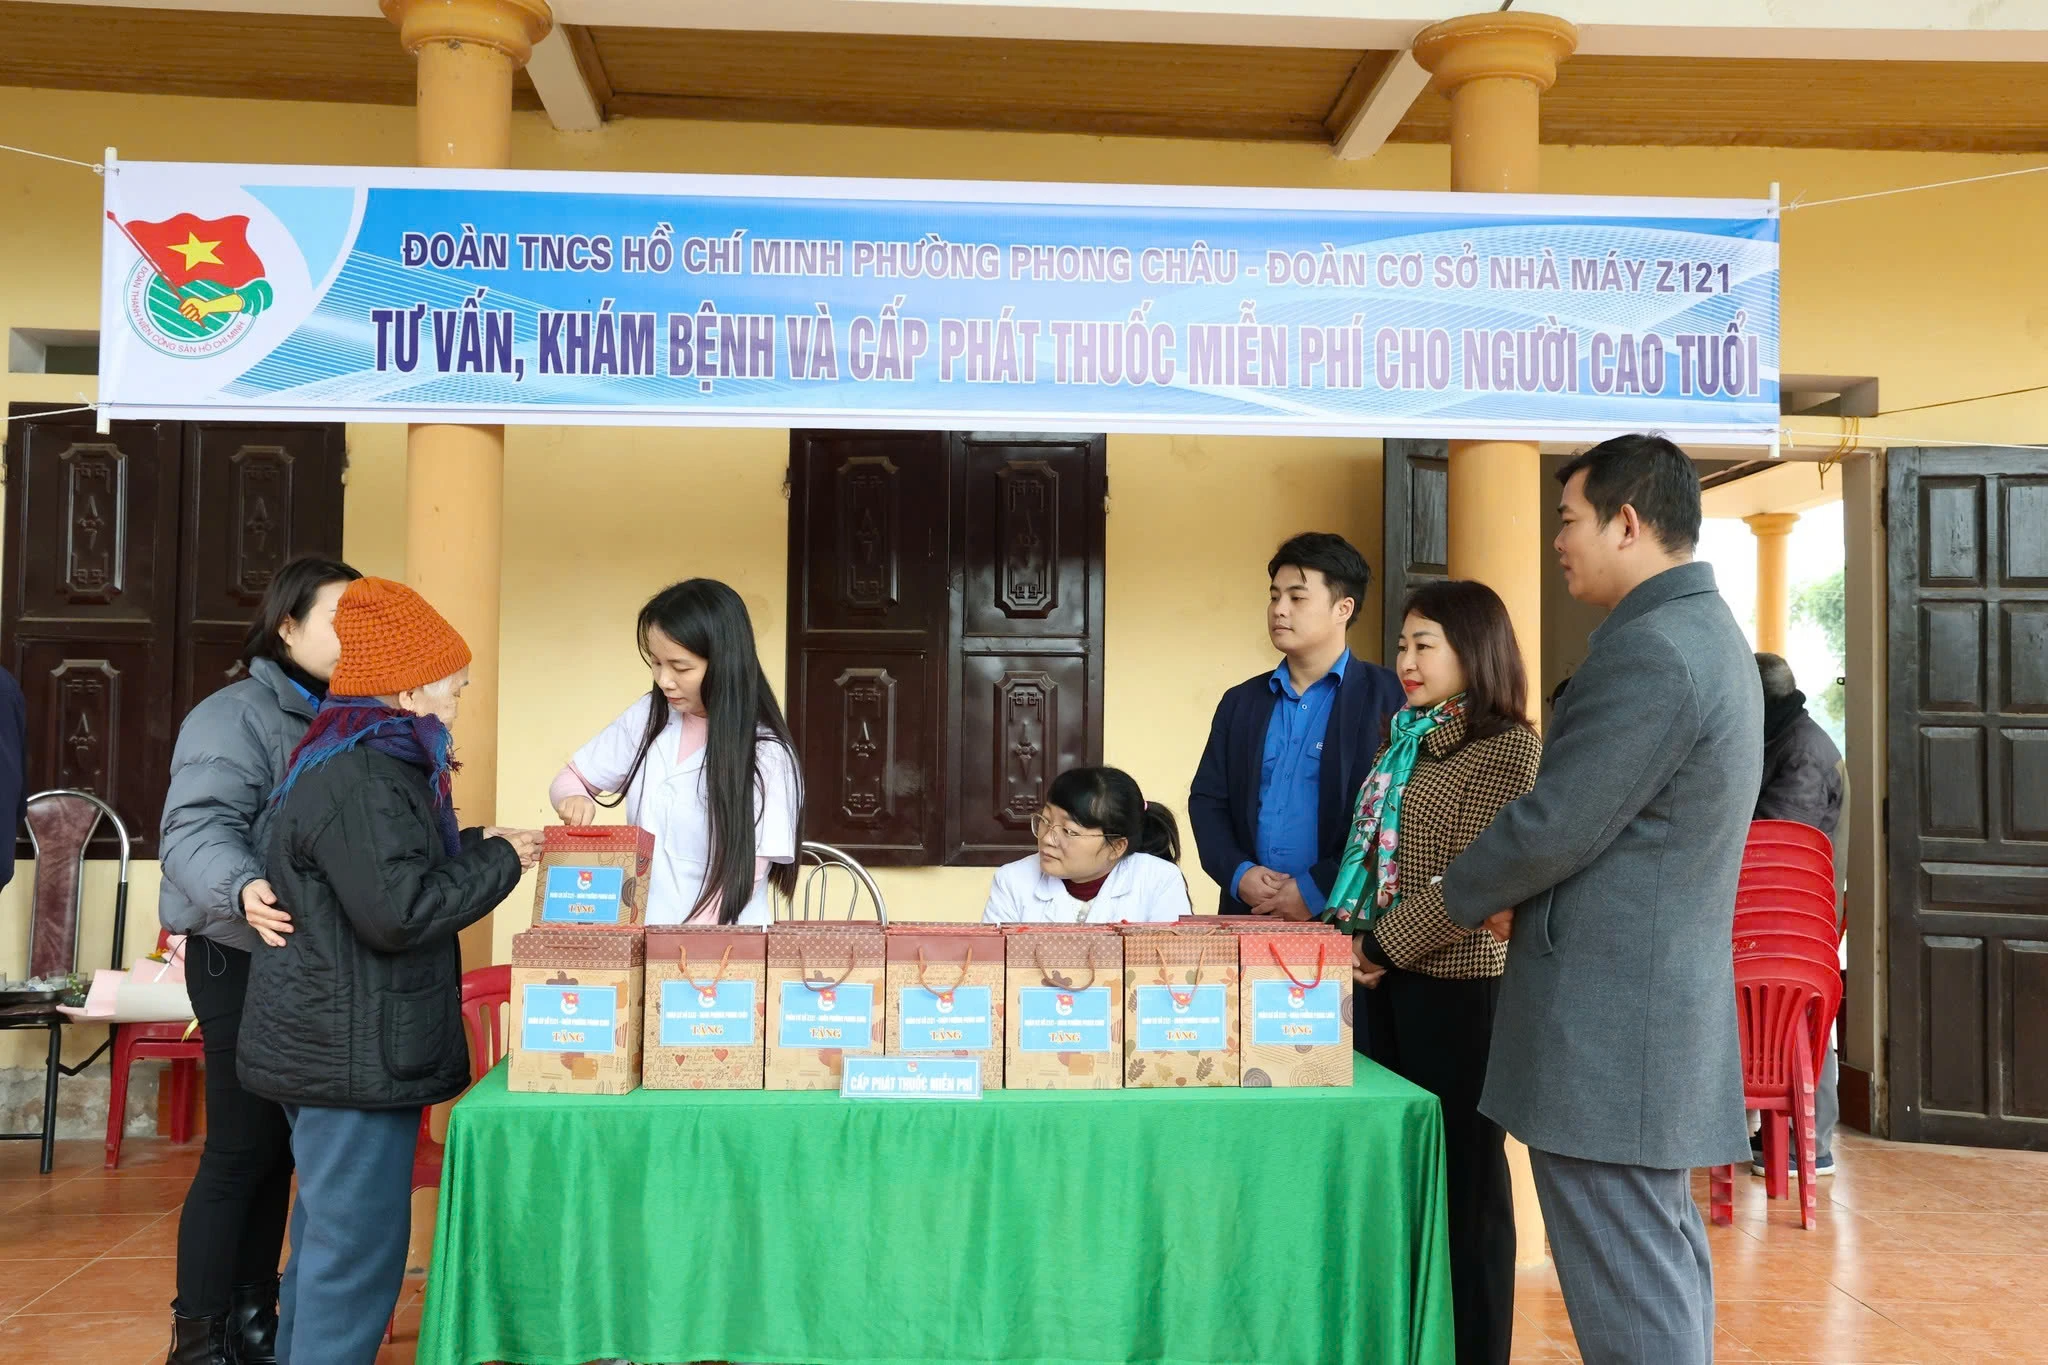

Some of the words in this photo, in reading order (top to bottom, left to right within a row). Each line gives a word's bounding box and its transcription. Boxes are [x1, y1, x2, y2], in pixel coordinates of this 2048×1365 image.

[402, 223, 507, 269] ĐOÀN
[518, 233, 612, 272] TNCS
[622, 222, 674, 273] HỒ
[682, 229, 747, 274] CHÍ
[751, 239, 843, 276] MINH
[853, 232, 1000, 280] PHƯỜNG
[1010, 245, 1131, 283] PHONG
[1140, 240, 1238, 284] CHÂU
[1266, 243, 1366, 287] ĐOÀN
[1376, 252, 1423, 288] CƠ
[1434, 242, 1479, 290] SỞ
[1490, 247, 1560, 292] NHÀ
[1571, 250, 1645, 293] MÁY
[1656, 262, 1731, 294] Z121
[131, 291, 142, 318] THANH
[227, 321, 246, 341] MINH
[371, 303, 426, 373] TƯ
[432, 286, 526, 383] VẤN,
[538, 298, 655, 376] KHÁM
[668, 299, 774, 392] BỆNH
[786, 302, 838, 381] VÀ
[849, 294, 929, 382] CẤP
[939, 306, 1040, 383] PHÁT
[1051, 300, 1177, 386] THUỐC
[1187, 299, 1288, 388] MIỄN
[1300, 313, 1364, 390] PHÍ
[1375, 327, 1450, 391] CHO
[1463, 316, 1577, 393] NGƯỜI
[1590, 332, 1664, 395] CAO
[1676, 309, 1760, 397] TUỔI
